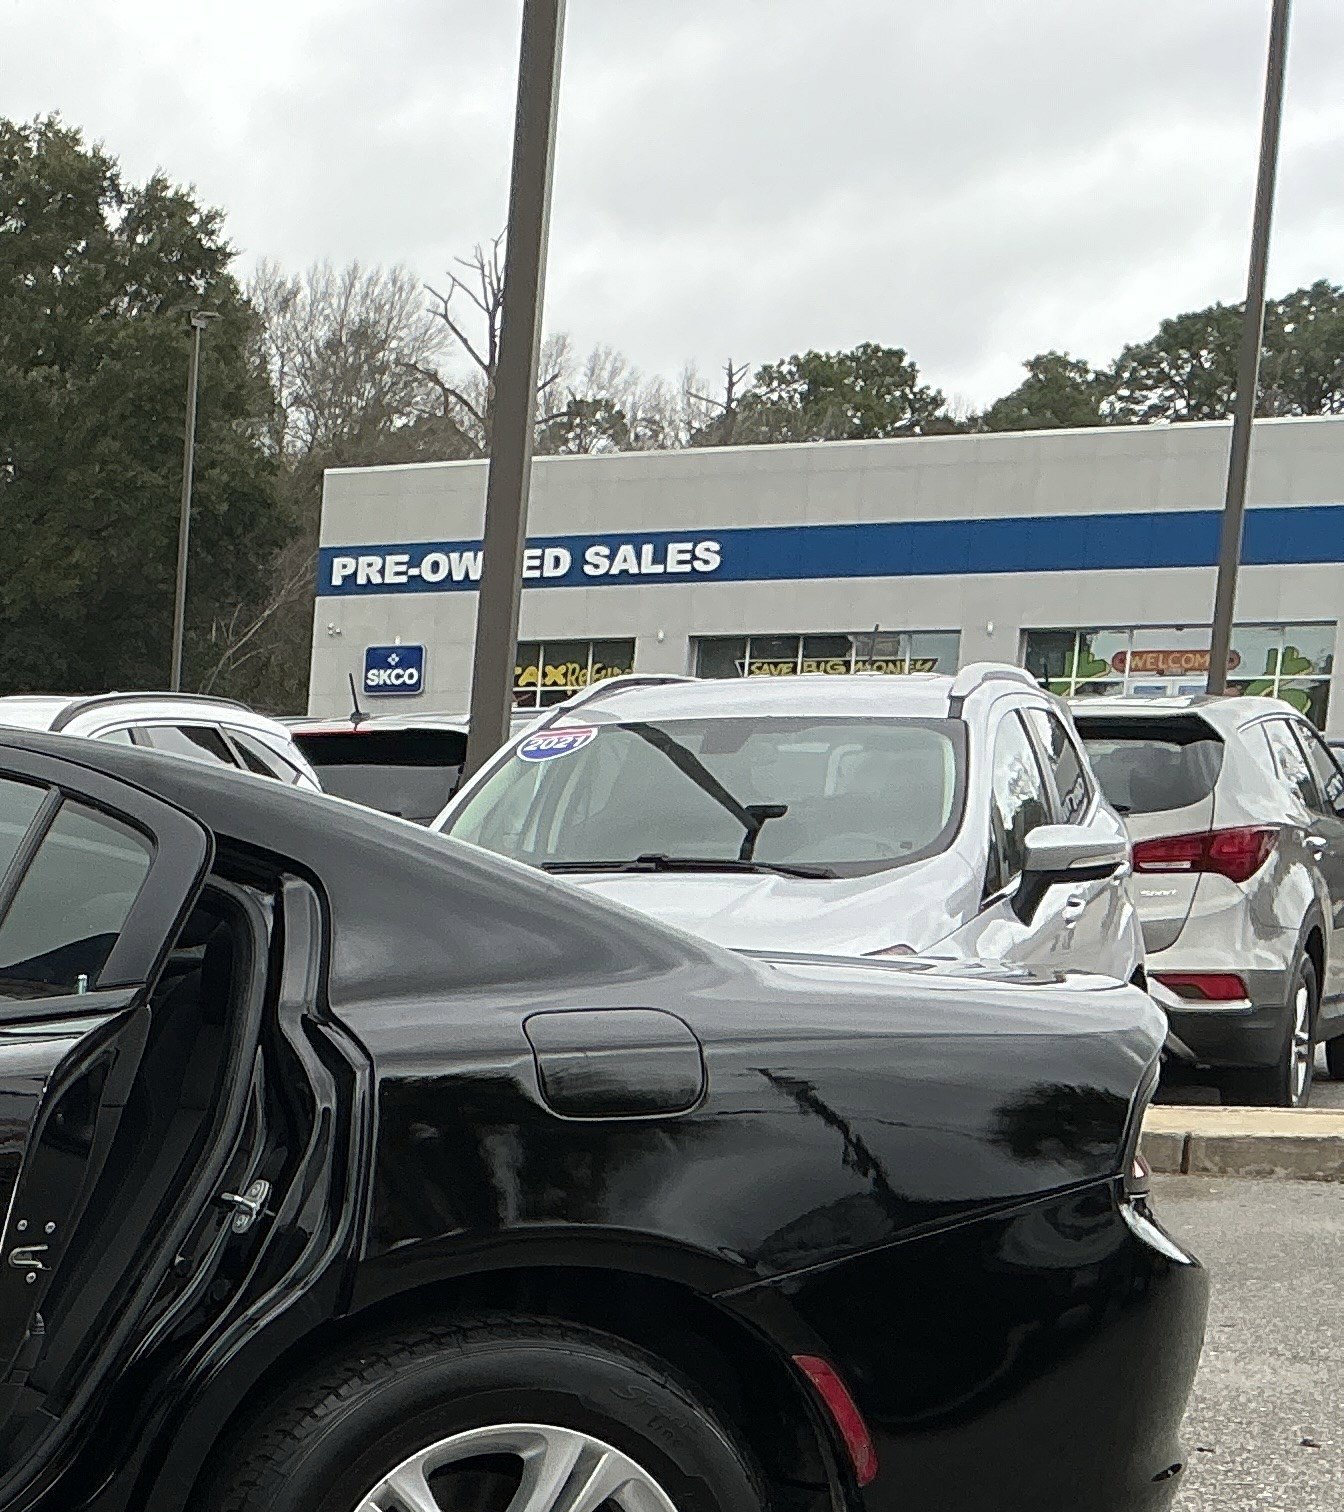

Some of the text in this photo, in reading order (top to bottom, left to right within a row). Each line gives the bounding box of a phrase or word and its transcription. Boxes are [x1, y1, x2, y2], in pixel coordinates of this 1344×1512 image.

[330, 540, 723, 587] PRE-OWED SALES
[750, 662, 794, 677] SAVE
[802, 660, 847, 675] BIG
[1131, 652, 1211, 670] WELCOM
[365, 666, 420, 687] SKCO
[522, 734, 587, 752] 2021
